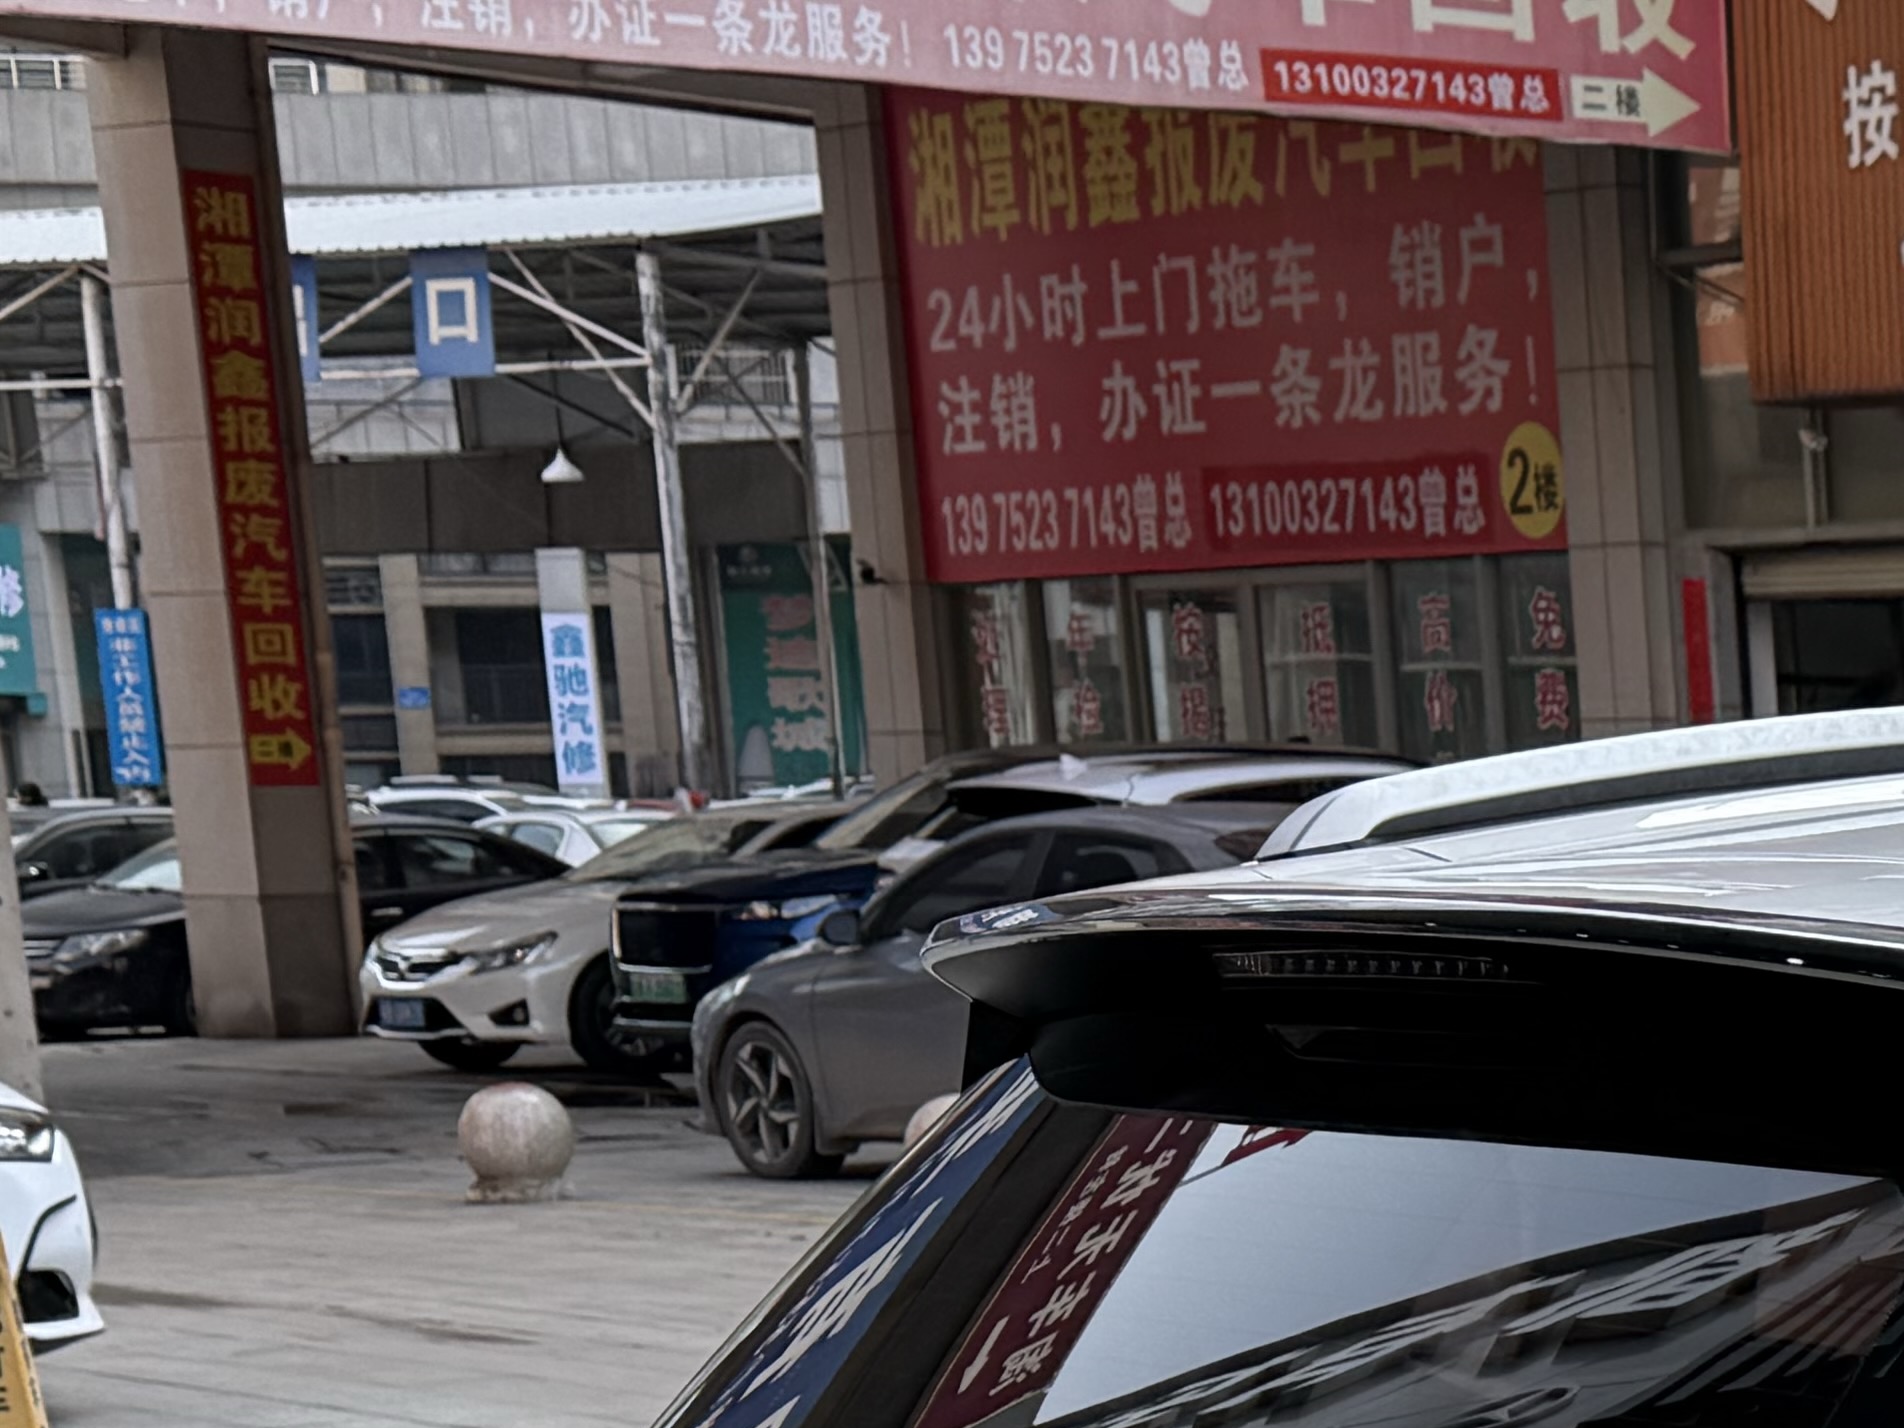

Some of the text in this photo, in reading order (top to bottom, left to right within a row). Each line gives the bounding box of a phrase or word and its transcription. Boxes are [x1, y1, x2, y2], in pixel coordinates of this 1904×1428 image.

[1273, 59, 1550, 114] 13100327143曾总
[194, 186, 305, 720] 湘潭润鑫报废汽车回收
[1209, 462, 1488, 539] 13100327143曾总
[1504, 447, 1560, 516] 2楼
[549, 623, 597, 775] 鑫驰汽修
[1417, 591, 1458, 732] 高价
[1529, 585, 1569, 731] 免费
